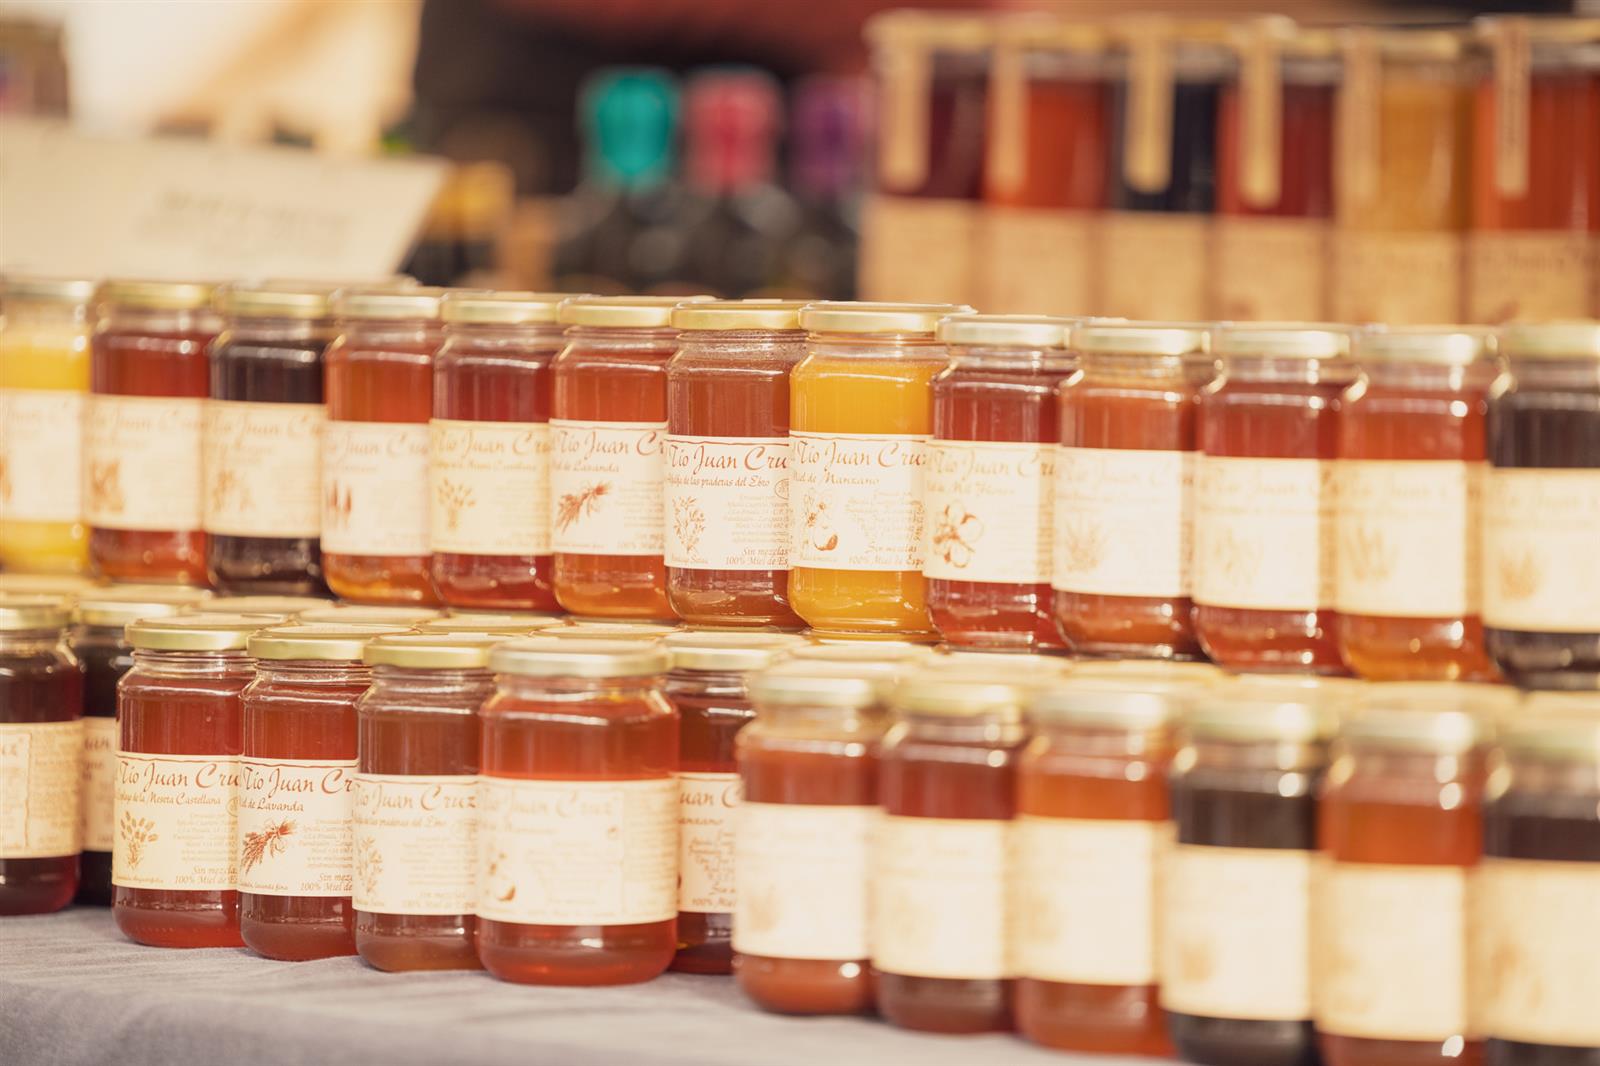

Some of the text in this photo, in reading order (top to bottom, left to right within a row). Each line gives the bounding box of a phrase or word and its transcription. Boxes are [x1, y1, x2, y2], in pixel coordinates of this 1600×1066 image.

[583, 431, 629, 460] Juan
[693, 445, 737, 475] Juan
[744, 446, 788, 471] Cru
[824, 441, 871, 472] Juan
[962, 449, 1008, 481] Juan
[1017, 447, 1055, 476] Cru
[701, 476, 733, 488] praderas
[735, 476, 746, 486] del
[143, 762, 188, 792] Juan
[195, 763, 238, 788] Cru
[268, 767, 313, 798] Juan
[321, 768, 352, 794] Cr
[150, 792, 174, 804] Meseta
[175, 792, 221, 805] Castellana
[257, 797, 304, 812] Lavanda
[372, 783, 413, 815] Juan
[420, 784, 477, 811] Cruz
[679, 790, 714, 807] uan
[677, 817, 723, 827] anzano
[207, 865, 238, 875] mezcla
